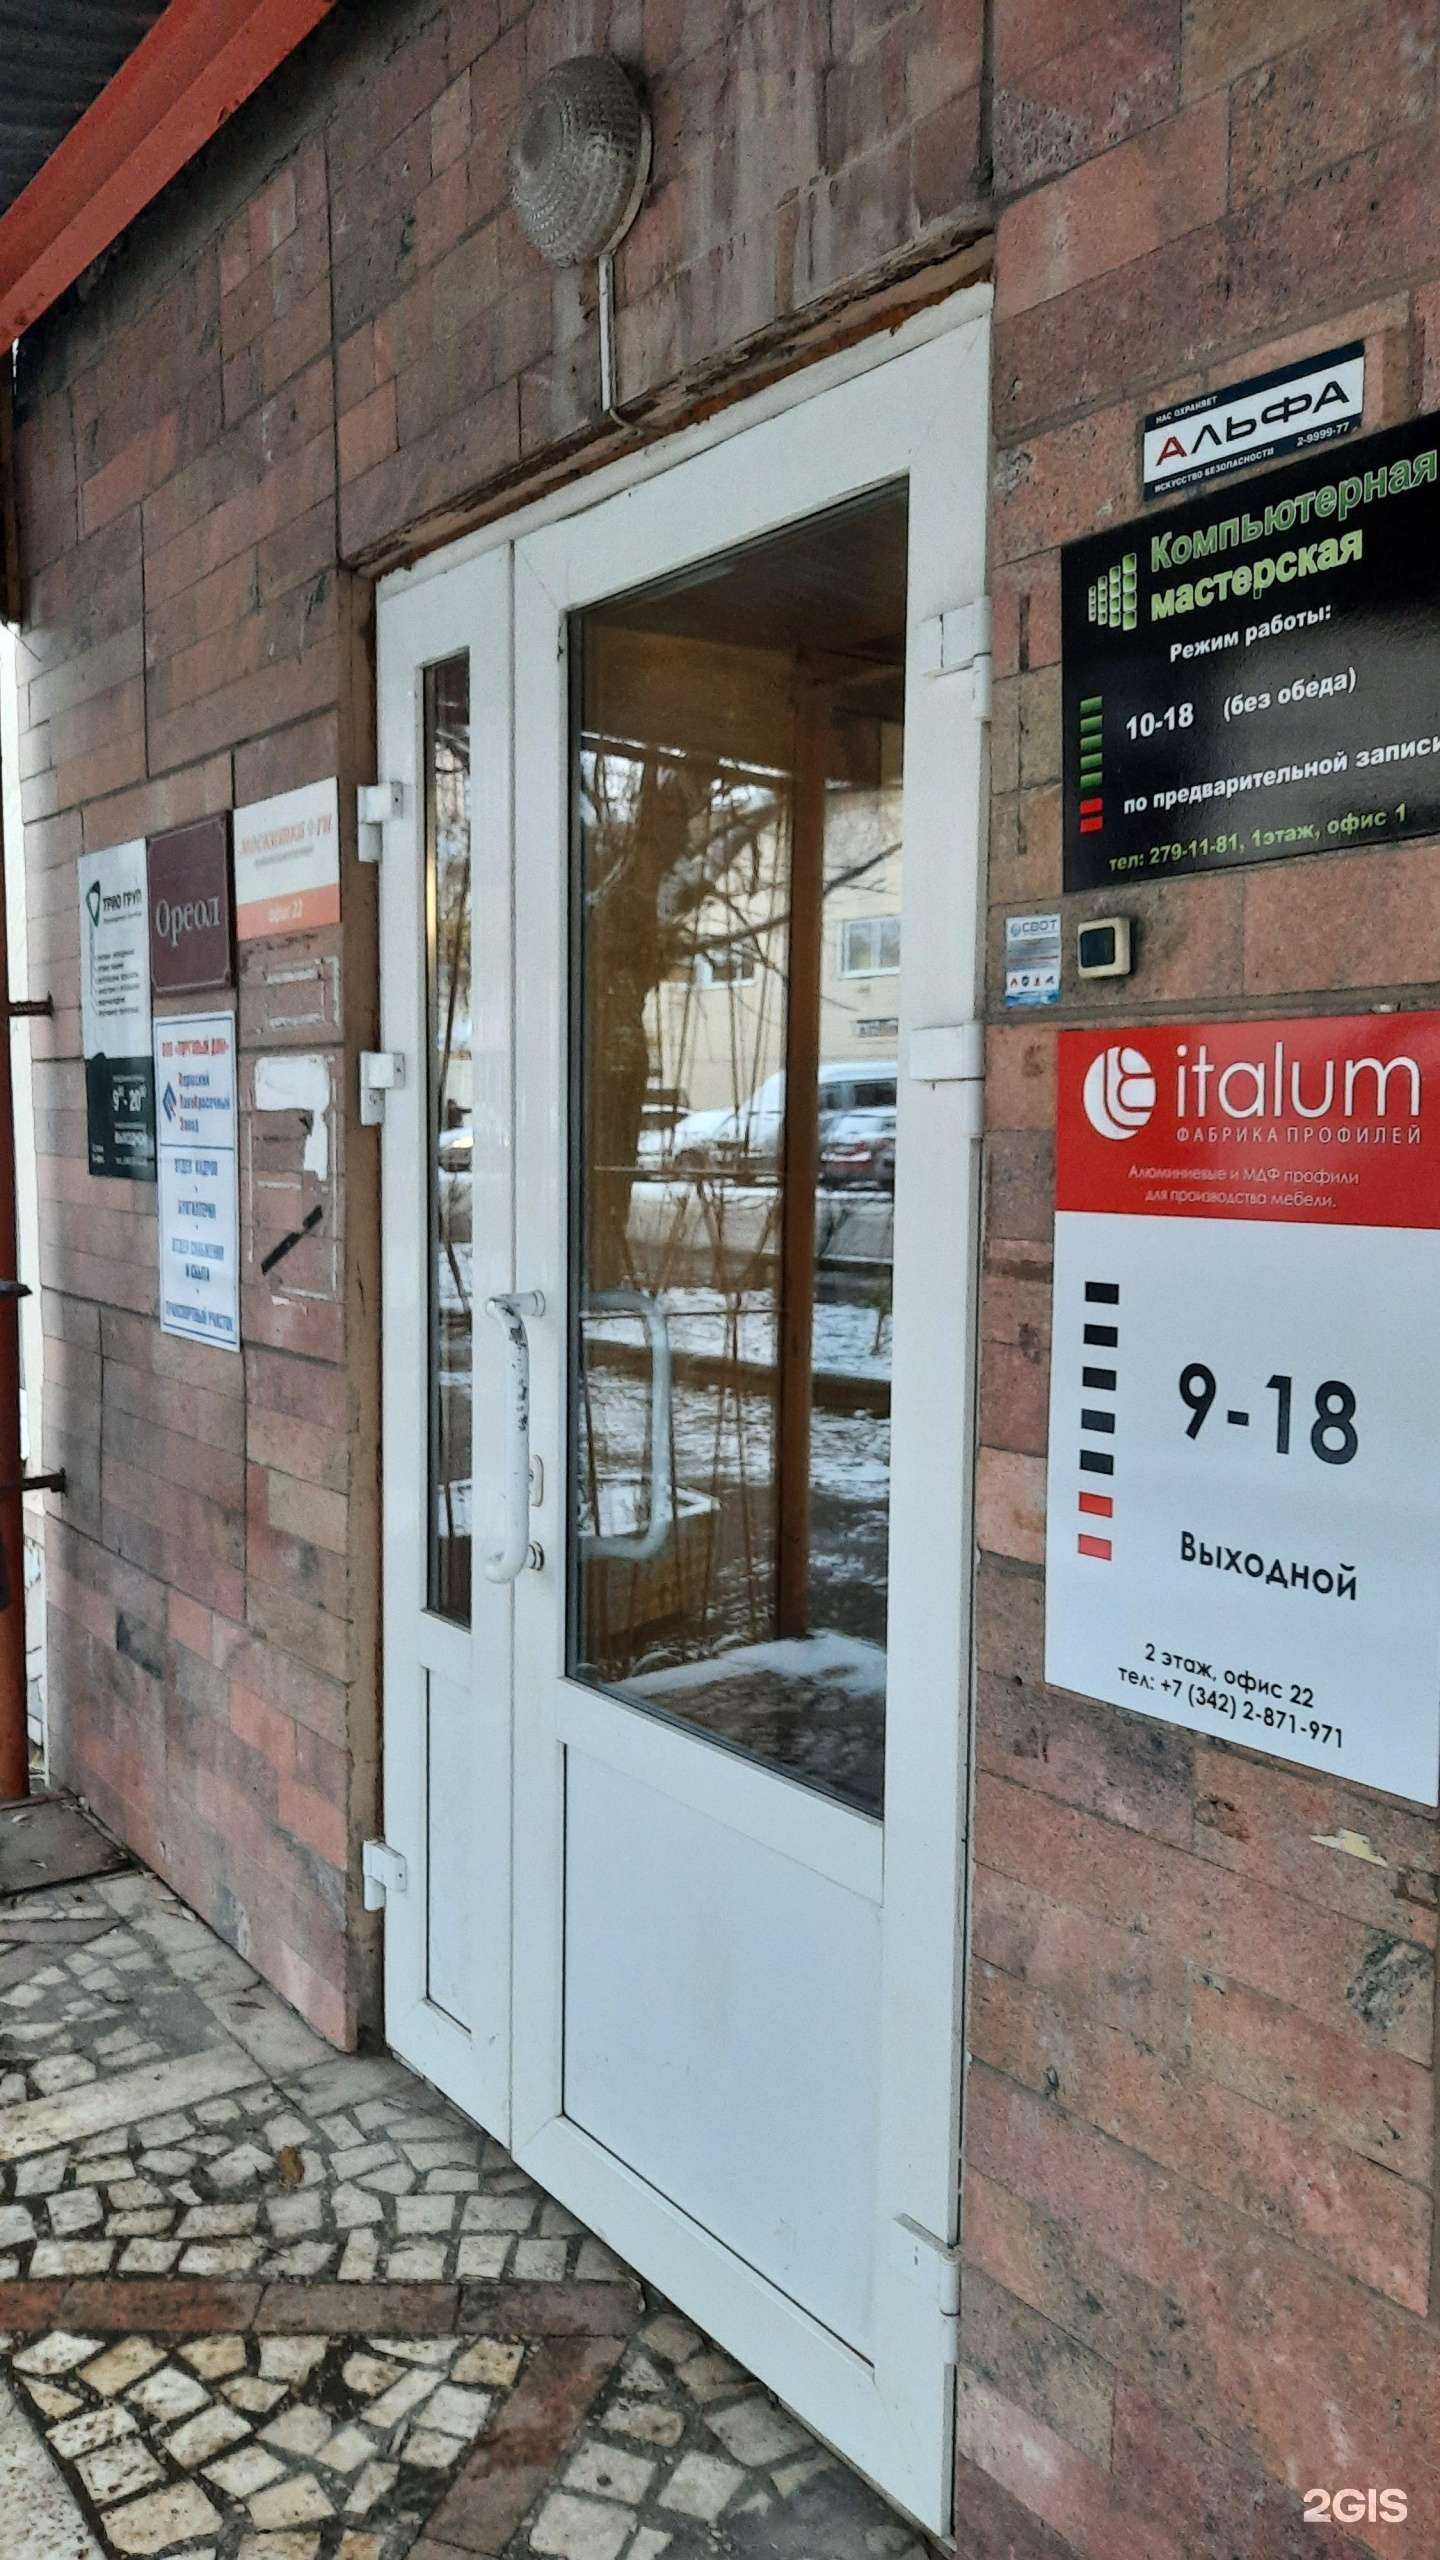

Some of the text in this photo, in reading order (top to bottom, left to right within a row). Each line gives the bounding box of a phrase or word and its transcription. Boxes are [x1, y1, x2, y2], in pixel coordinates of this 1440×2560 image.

[1155, 395, 1218, 425] НАС ОХРАНЯЕТ
[1155, 380, 1351, 467] АЛЬФА
[1296, 421, 1351, 448] 2-9999-77
[1154, 447, 1275, 494] ИСКУССТВО БЕЗОПАСНОСТИ
[1150, 449, 1438, 574] Компьютерная
[1150, 529, 1364, 621] мастерская
[1170, 604, 1332, 663] Режим работы:
[1125, 666, 1358, 741] 10-18 (без обеда)
[1123, 795, 1149, 815] по
[1153, 750, 1349, 810] предварительной
[1108, 852, 1145, 872] тел:
[1150, 832, 1246, 866] 279-11-81,
[1327, 810, 1387, 839] офис
[1395, 803, 1407, 824] 1
[156, 895, 220, 949] Ореол
[1176, 1041, 1422, 1119] italum
[1176, 1123, 1422, 1145] ФАБРИКА ПРОФИЛЕЙ
[1127, 1165, 1360, 1187] Алюминиевые и МДФ профили
[1145, 1188, 1338, 1209] для производства мебели.
[1178, 1361, 1359, 1467] 9-18
[1179, 1530, 1357, 1601] Выходной
[1117, 1666, 1345, 1750] тел: +7 (342) 2-871-971
[1144, 1643, 1315, 1708] 2 этаж, офис 22
